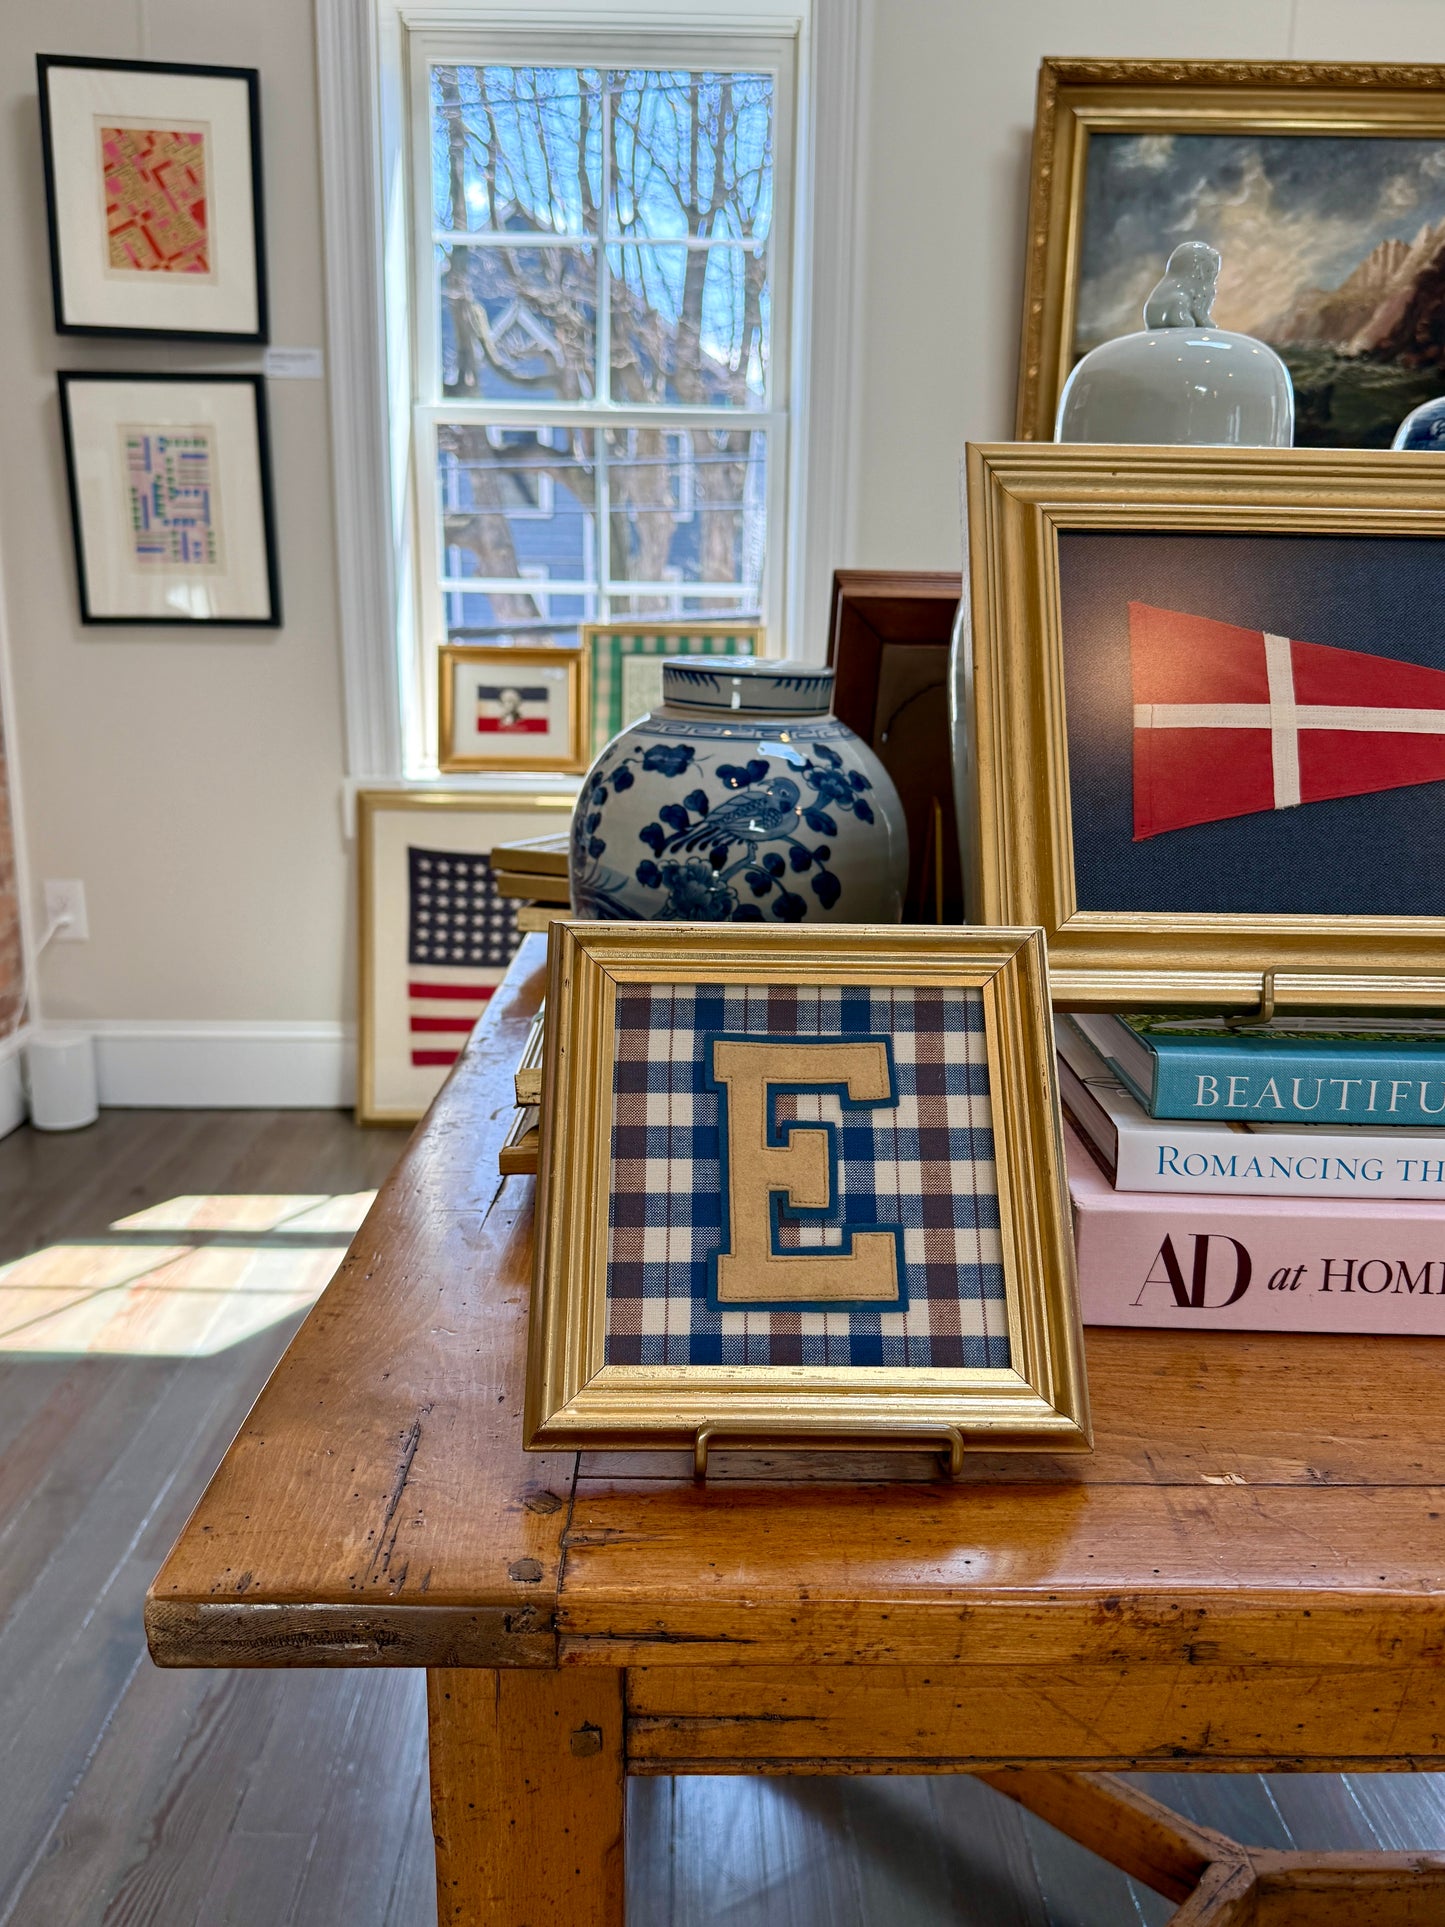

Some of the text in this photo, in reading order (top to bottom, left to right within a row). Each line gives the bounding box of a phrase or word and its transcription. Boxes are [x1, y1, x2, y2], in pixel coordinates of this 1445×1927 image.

[1194, 1074, 1445, 1114] BEAUTIFU
[1155, 1145, 1445, 1182] ROMANCING TH
[1129, 1233, 1253, 1308] AD
[1267, 1264, 1308, 1291] at
